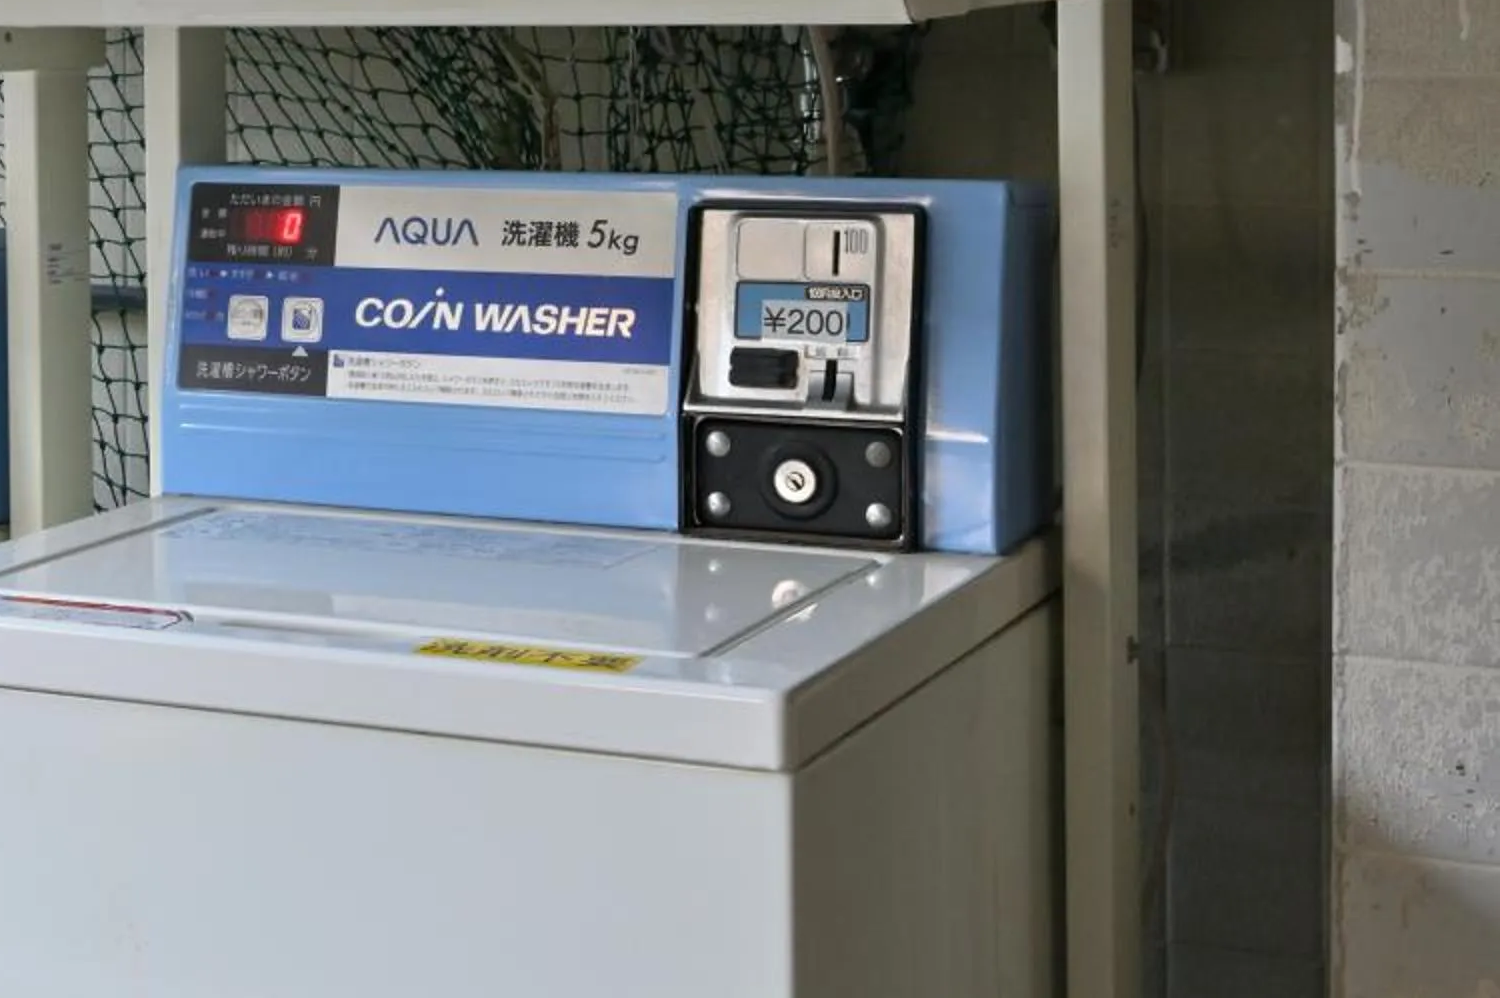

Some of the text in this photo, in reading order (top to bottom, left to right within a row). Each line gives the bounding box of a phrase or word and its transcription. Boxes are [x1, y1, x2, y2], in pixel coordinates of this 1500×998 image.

[282, 212, 303, 240] 0
[374, 216, 640, 255] AQUA 洗濯機 5kg
[843, 228, 870, 255] 100
[473, 302, 637, 339] WASHER
[763, 306, 845, 337] ¥200
